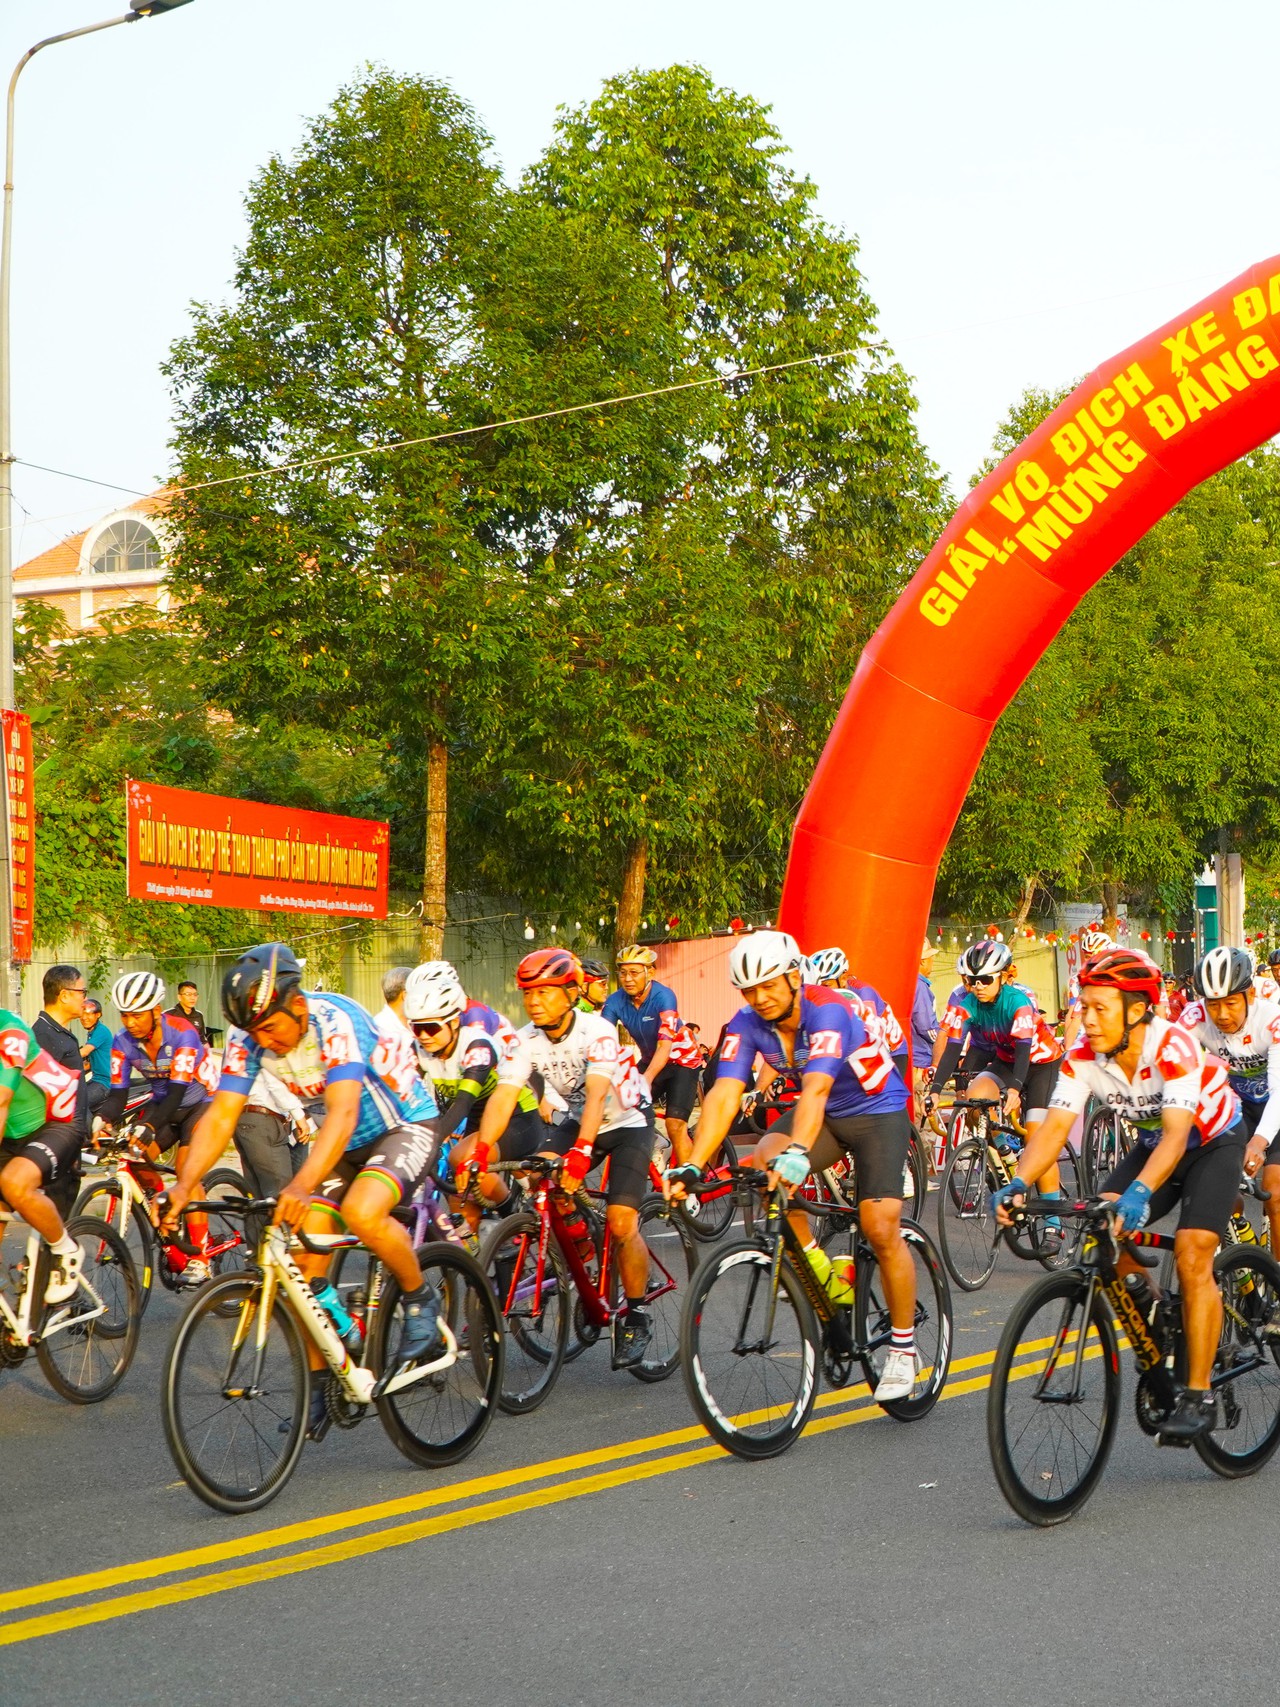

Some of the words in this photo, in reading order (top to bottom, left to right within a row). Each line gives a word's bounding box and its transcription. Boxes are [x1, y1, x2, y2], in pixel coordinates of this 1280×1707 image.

[1143, 334, 1280, 440] ĐẢNG
[919, 527, 998, 627] GIẢI
[990, 460, 1050, 523] VÔ
[1050, 362, 1155, 467] ĐỊCH
[1161, 310, 1226, 373] XE
[140, 805, 155, 866] GIẢI
[156, 813, 168, 868] VÔ
[188, 826, 200, 872] XE
[232, 832, 251, 878] THAO
[363, 851, 378, 892] 2025
[590, 1037, 617, 1059] 48
[808, 1030, 841, 1057] 27
[1012, 1015, 1034, 1032] 246
[174, 1053, 195, 1074] 33
[1111, 1280, 1161, 1366] DOGMA
